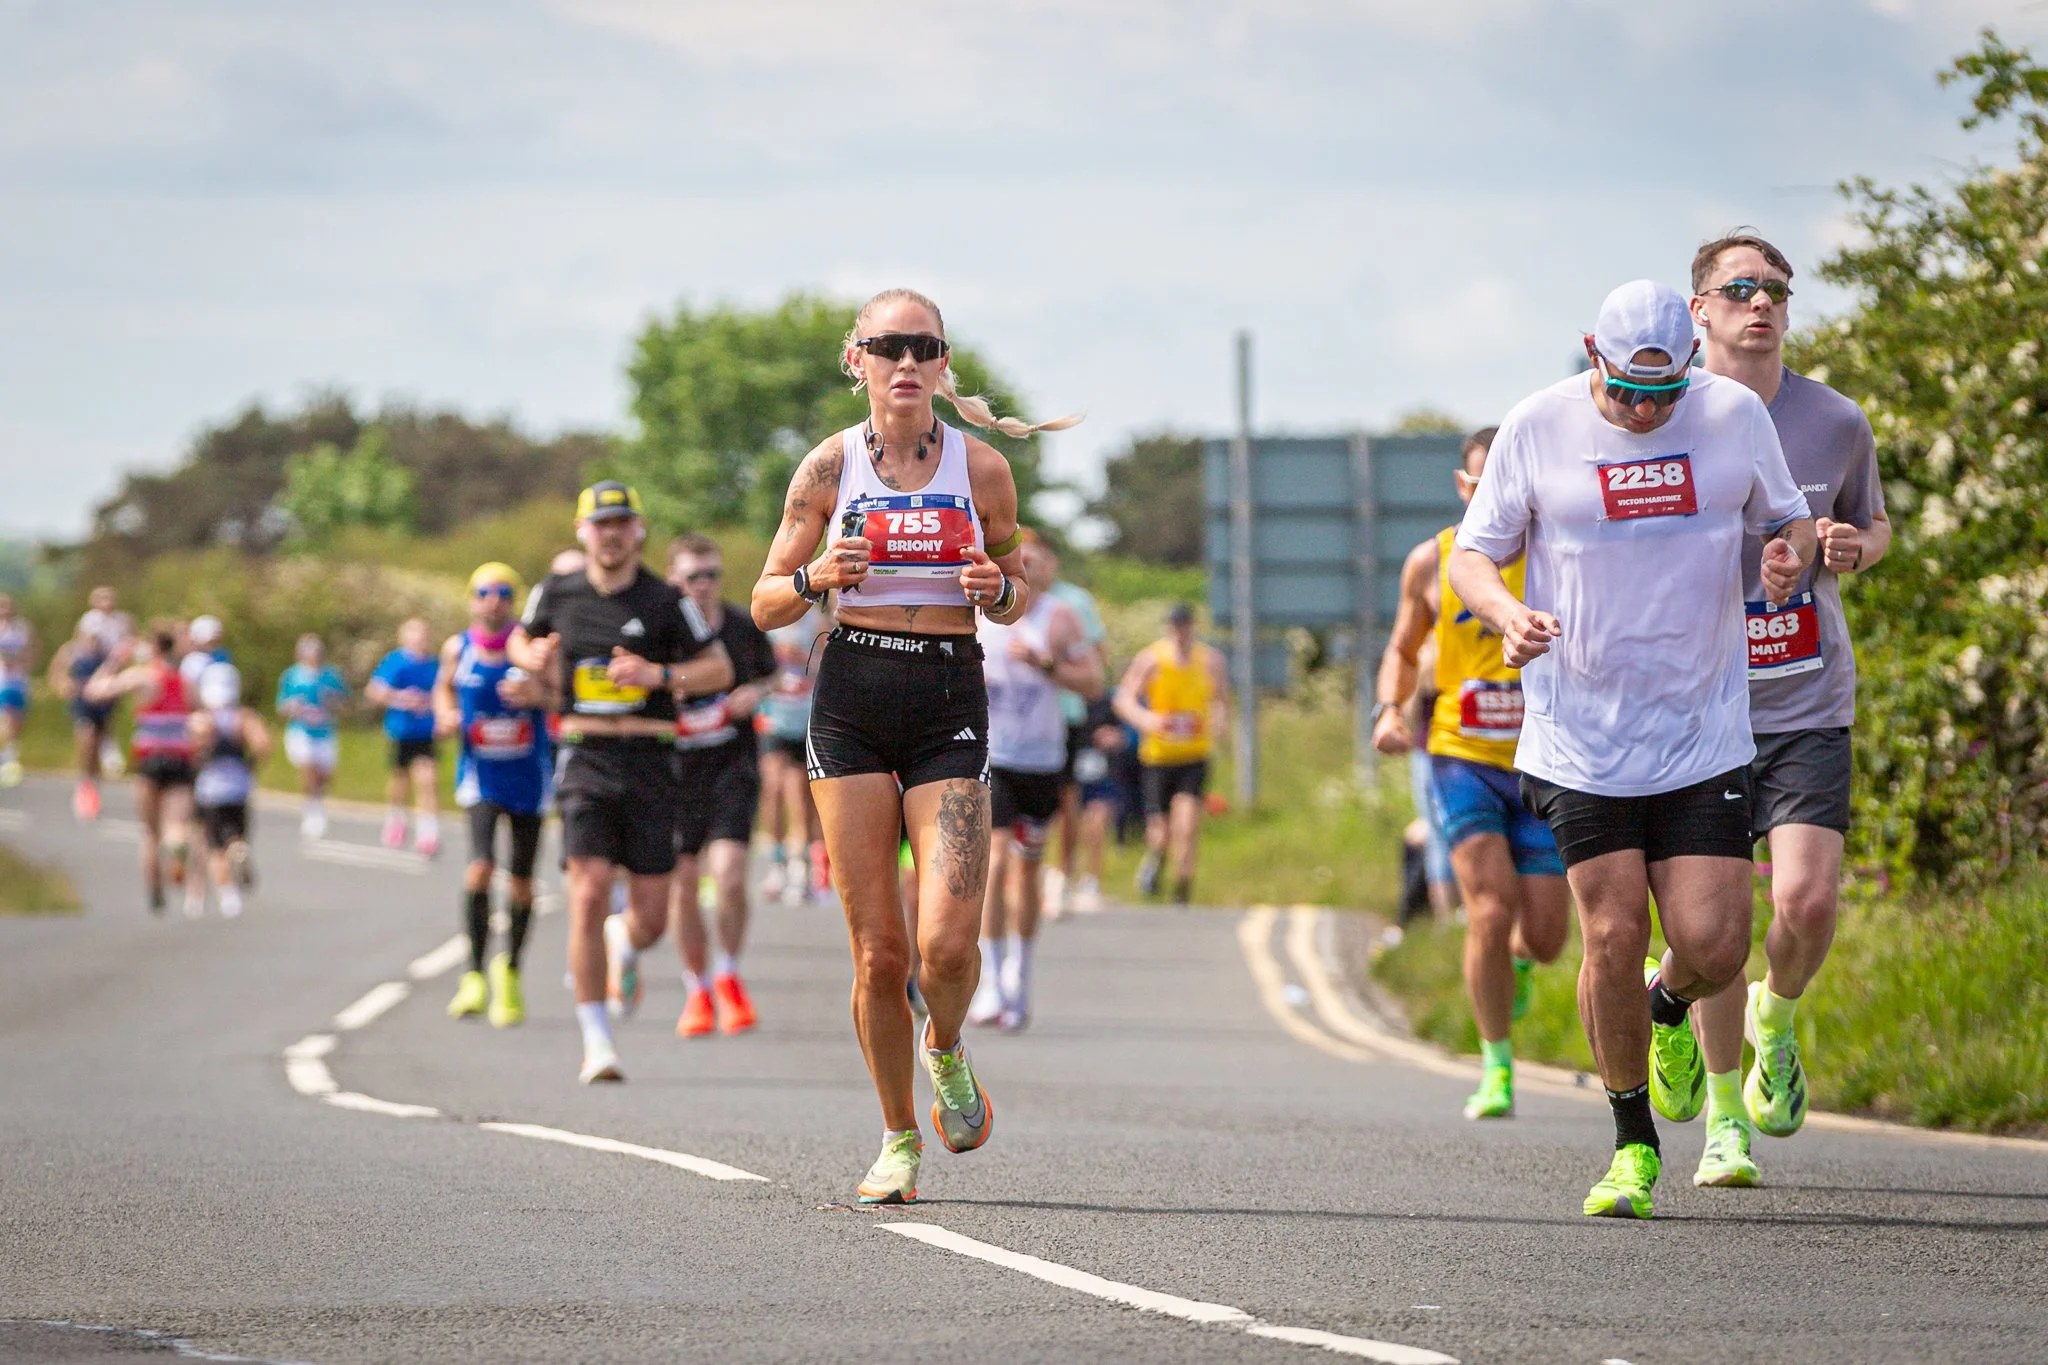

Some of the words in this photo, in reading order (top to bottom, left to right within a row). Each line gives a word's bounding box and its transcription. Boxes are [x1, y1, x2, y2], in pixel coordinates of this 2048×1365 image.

[1607, 463, 1685, 490] 2258
[1800, 483, 1828, 493] BANDIT
[1617, 498, 1646, 507] VICTOR
[1645, 494, 1682, 505] MARTINEZ
[885, 511, 941, 533] 755
[887, 540, 943, 552] BRIONY
[1750, 642, 1788, 656] MATT
